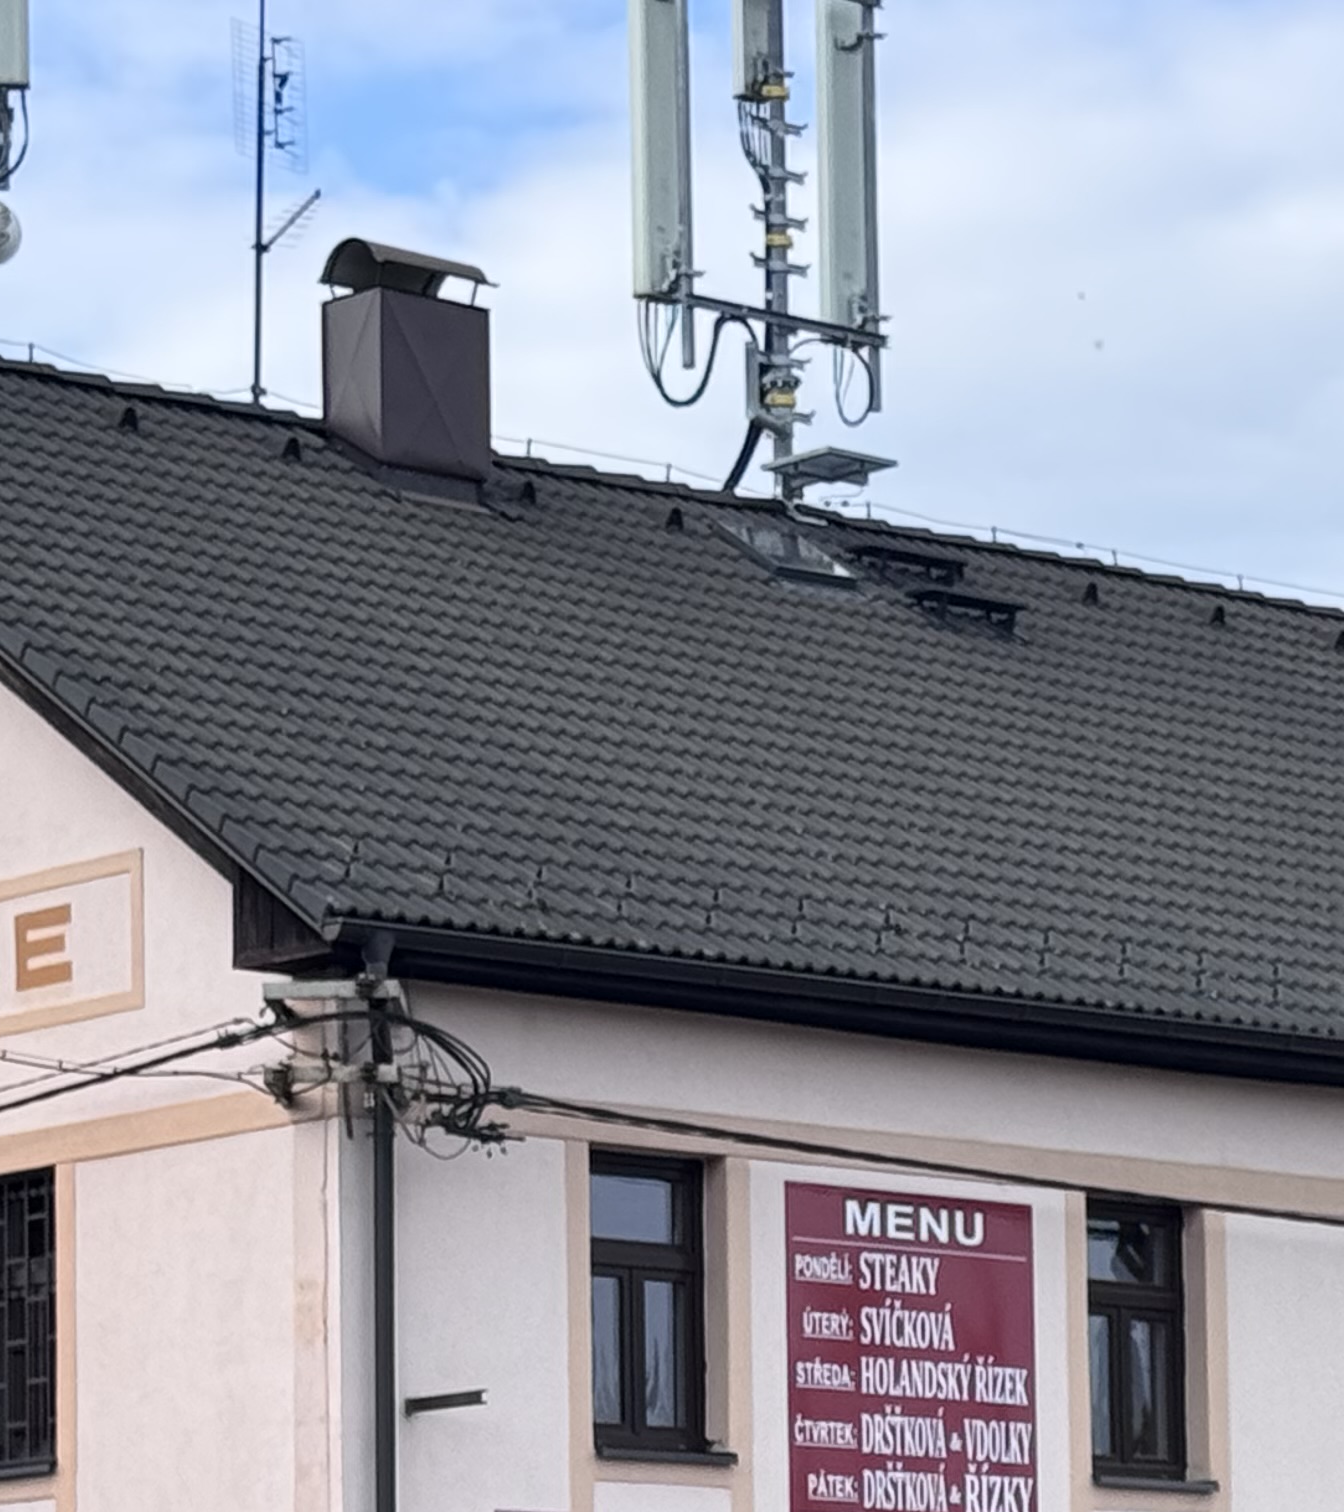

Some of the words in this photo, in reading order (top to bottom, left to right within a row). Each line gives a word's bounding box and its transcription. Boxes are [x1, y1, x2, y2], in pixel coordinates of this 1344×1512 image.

[844, 1199, 985, 1246] MENU
[859, 1252, 940, 1296] STEAKY
[860, 1298, 955, 1351] SVÍČKOVÁ
[861, 1353, 971, 1401] HOLANDSKÝ
[975, 1356, 1029, 1406] ŘÍZEK
[964, 1419, 1032, 1464] VDOLKY
